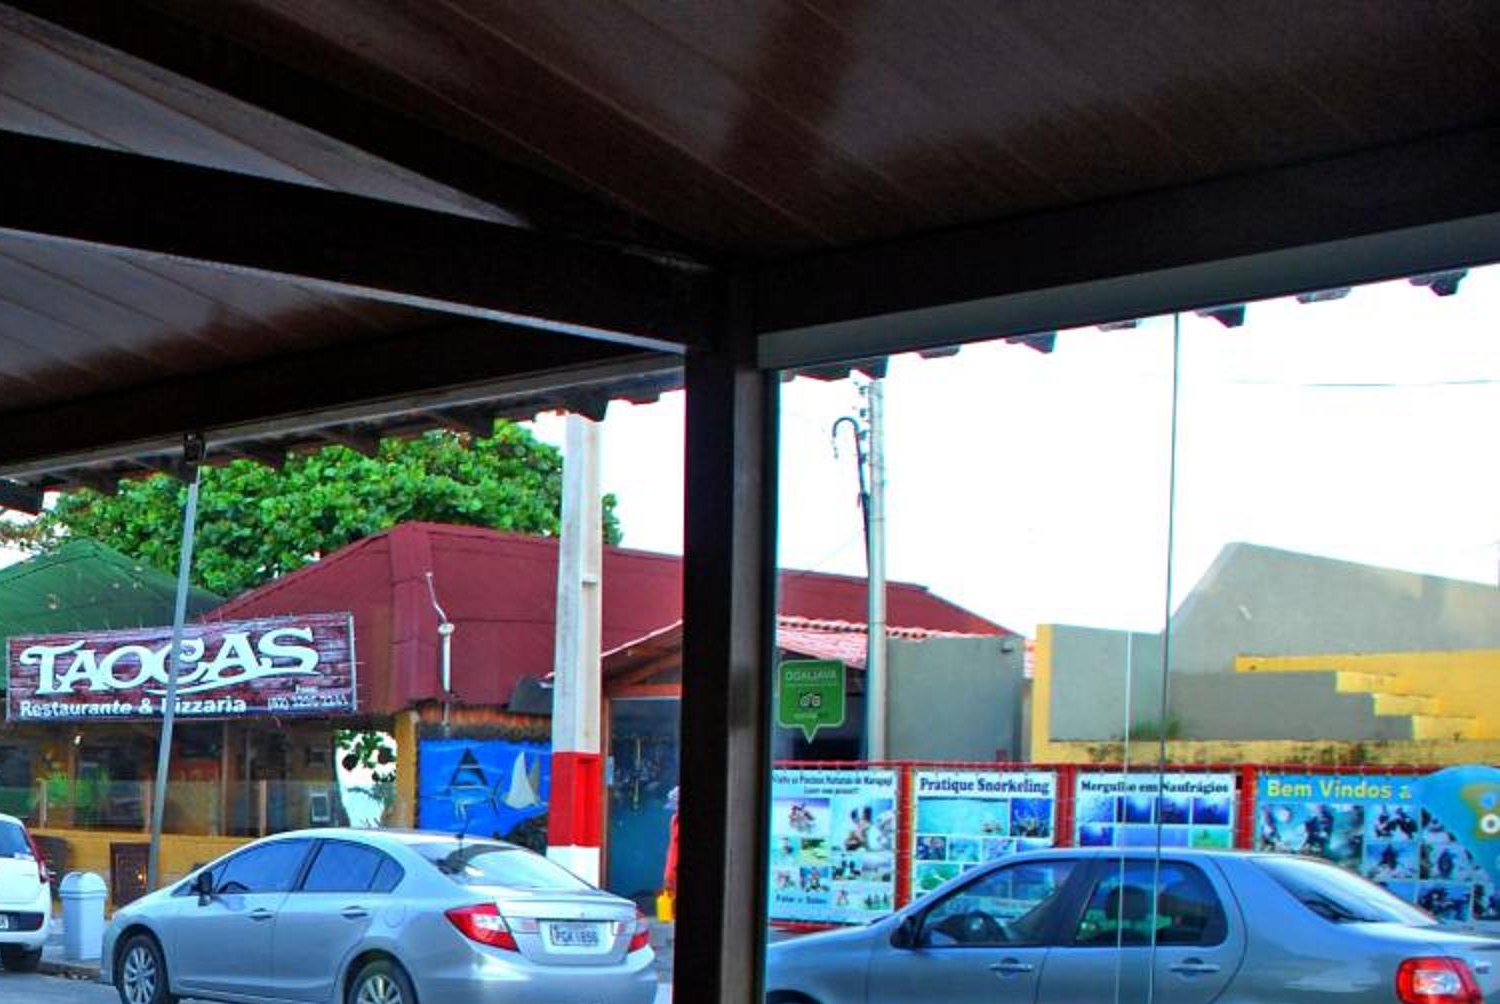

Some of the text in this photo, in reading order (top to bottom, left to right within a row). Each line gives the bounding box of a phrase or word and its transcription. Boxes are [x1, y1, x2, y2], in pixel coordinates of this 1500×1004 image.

[19, 626, 323, 695] TAOCAS
[20, 698, 132, 718] Restaurante
[138, 698, 154, 715] &
[920, 777, 1050, 796] Pratique Snorkeling
[1139, 783, 1158, 792] em
[1267, 779, 1312, 797] Bem
[1319, 779, 1392, 799] Vindos
